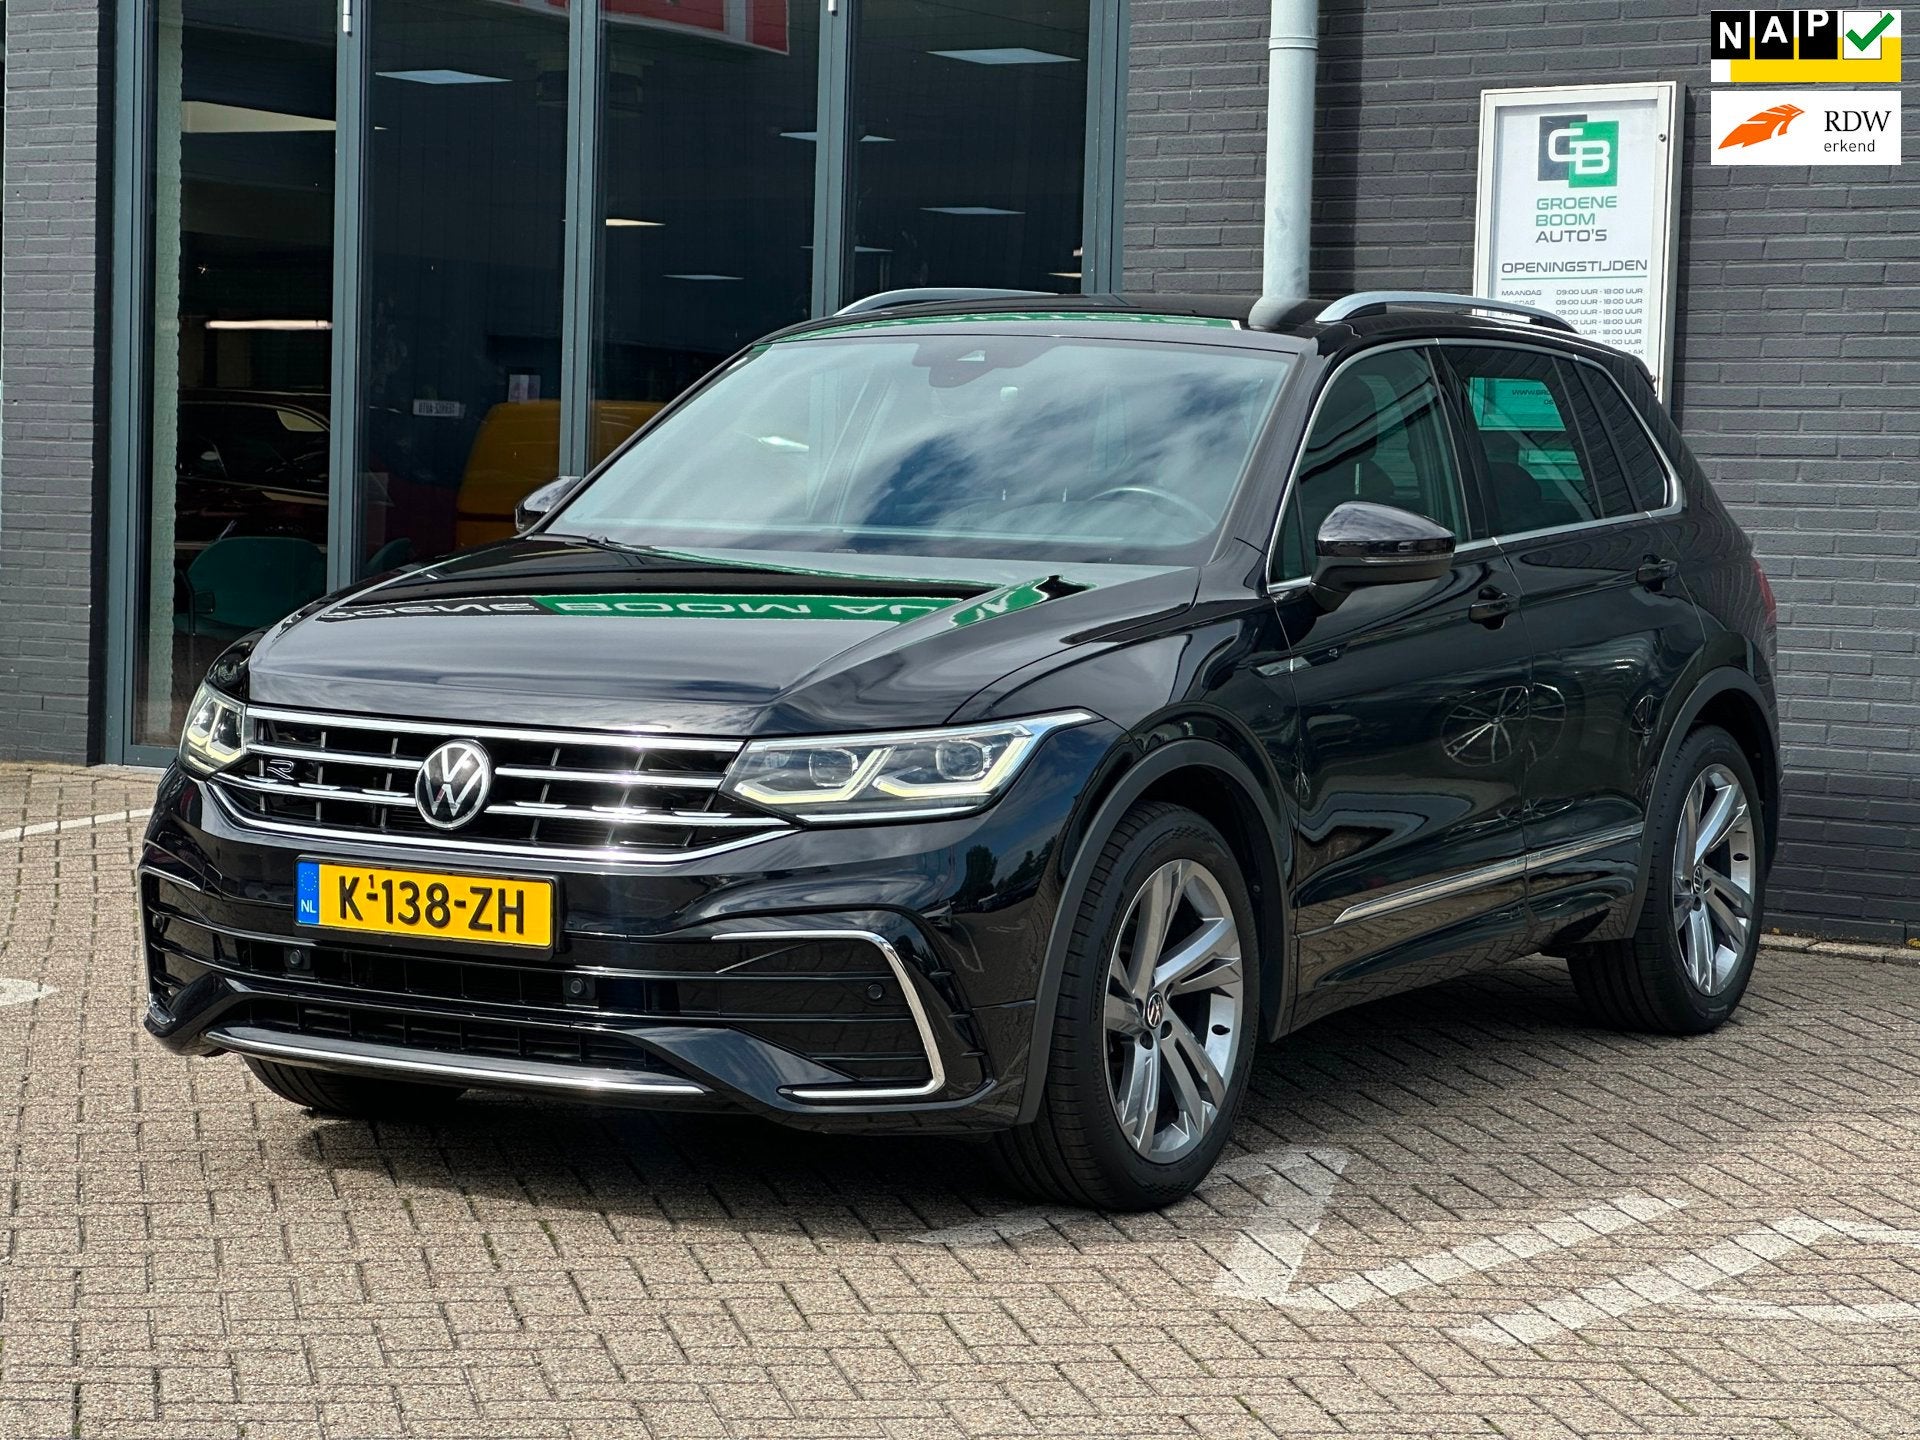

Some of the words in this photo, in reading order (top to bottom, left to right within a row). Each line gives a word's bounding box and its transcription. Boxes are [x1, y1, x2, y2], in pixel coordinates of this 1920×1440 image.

[1536, 196, 1617, 210] GROENE
[1535, 213, 1596, 227] BOOM
[1535, 228, 1608, 243] AUTO'S
[1501, 259, 1648, 273] OPENINGSTIJDEN
[300, 899, 317, 914] NL
[338, 874, 525, 935] K-138-ZH
